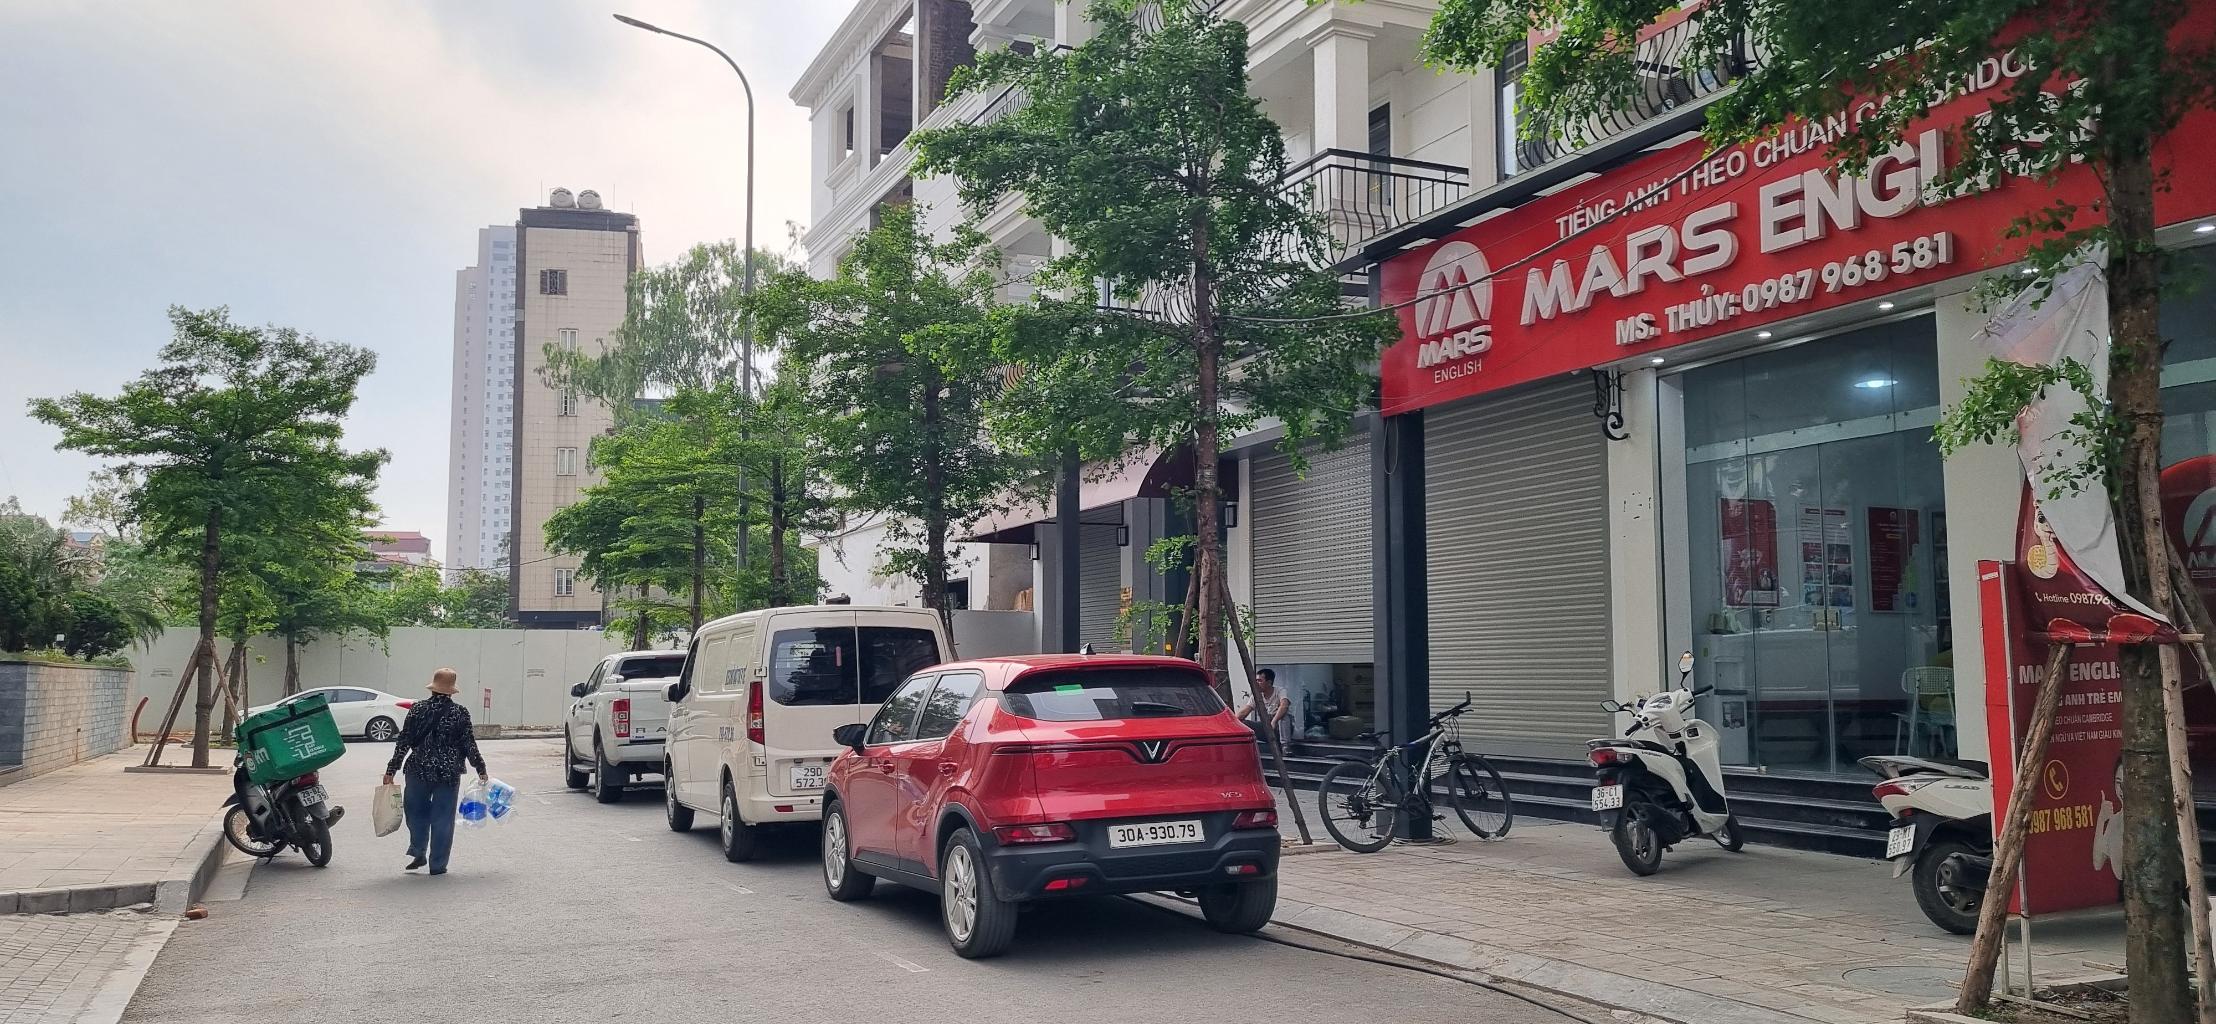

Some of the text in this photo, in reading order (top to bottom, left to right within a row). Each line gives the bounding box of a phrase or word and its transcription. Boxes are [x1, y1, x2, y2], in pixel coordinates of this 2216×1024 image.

[1556, 199, 1616, 239] TIẾNG
[1623, 178, 1670, 216] ANH
[1677, 151, 1748, 195] THEO
[1520, 201, 1739, 326] MARS
[1742, 268, 1818, 312] 0987
[1821, 250, 1890, 293] 968
[1891, 231, 1953, 274] 581
[1417, 325, 1493, 368] MARS
[1434, 359, 1482, 384] ENGLISH
[2043, 593, 2069, 603] Hotline
[2065, 693, 2086, 706] ANH
[2082, 712, 2113, 723] CAMBRIDGE
[796, 777, 827, 788] 572.3
[803, 767, 823, 777] 29D
[2054, 805, 2073, 830] 968
[2075, 804, 2094, 829] 581
[1117, 824, 1196, 843] 30A-930.79
